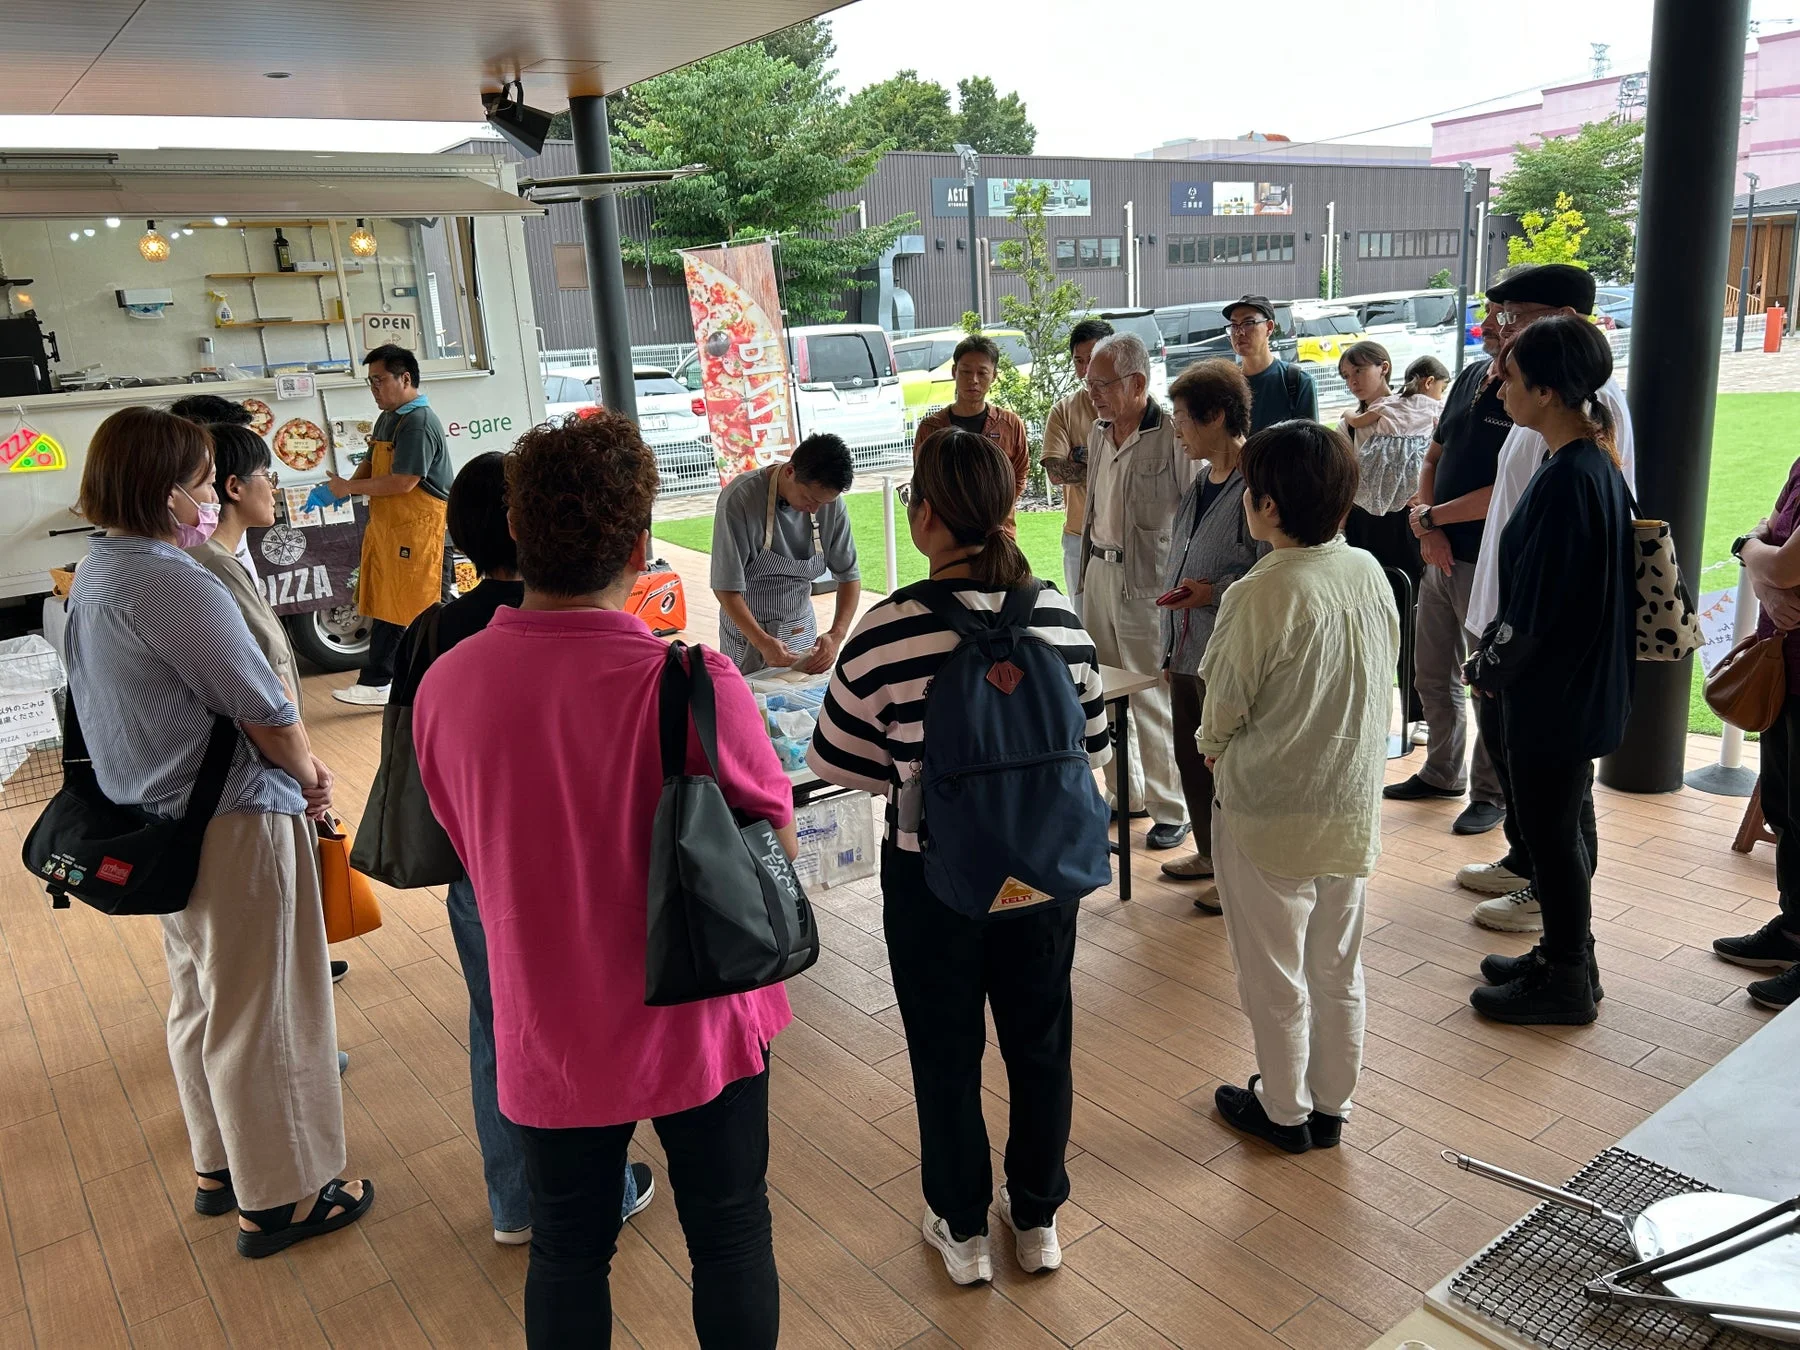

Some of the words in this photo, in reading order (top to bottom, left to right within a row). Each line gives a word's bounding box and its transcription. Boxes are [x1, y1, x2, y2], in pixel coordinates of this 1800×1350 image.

[369, 317, 410, 329] OPEN
[446, 417, 512, 439] e-gare
[0, 711, 44, 725] 慮ください
[761, 853, 798, 899] FACE
[1001, 893, 1033, 905] KELTY
